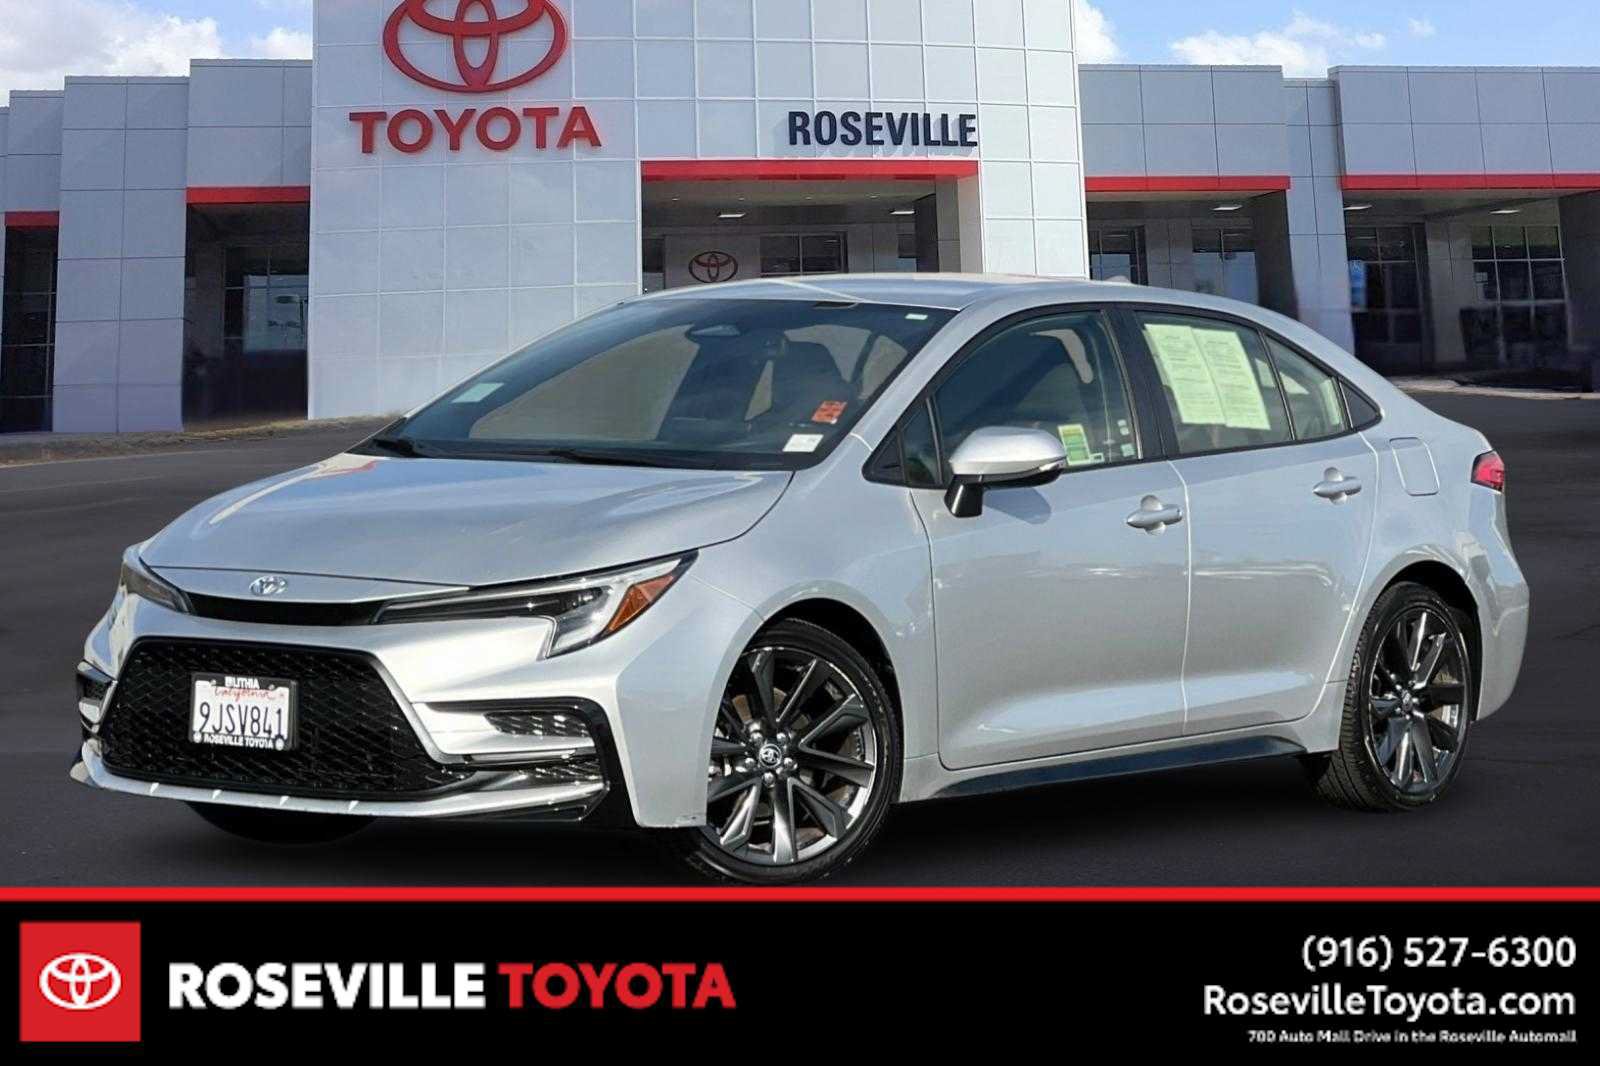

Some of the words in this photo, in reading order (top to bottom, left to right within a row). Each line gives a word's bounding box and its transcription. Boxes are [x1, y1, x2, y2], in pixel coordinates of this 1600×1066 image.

[349, 106, 602, 154] TOYOTA
[788, 110, 978, 147] ROSEVILLE
[200, 701, 283, 738] 9JSV841
[203, 732, 244, 746] ROSEVILLE
[245, 737, 274, 749] TOYOTA
